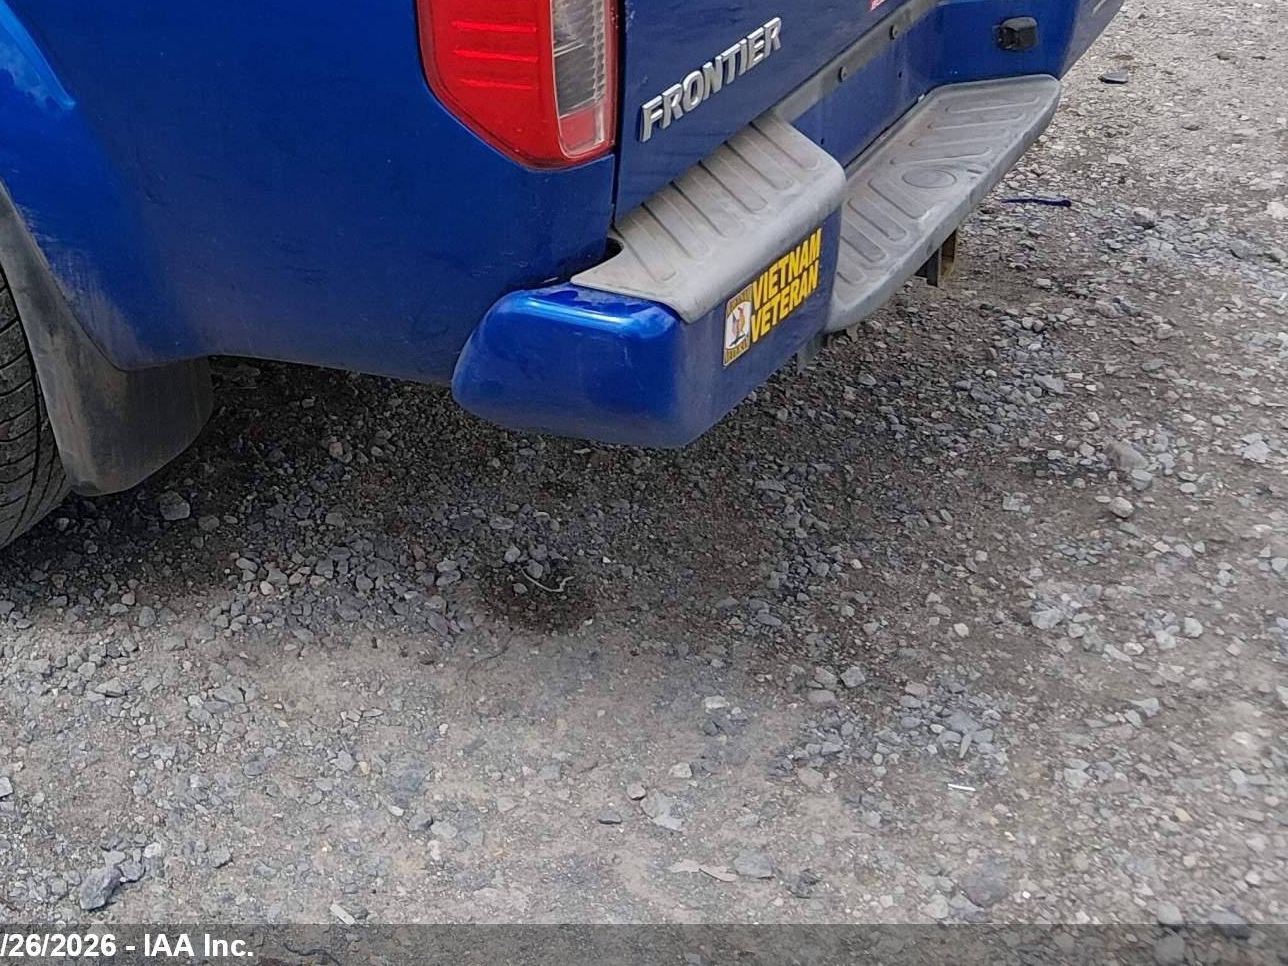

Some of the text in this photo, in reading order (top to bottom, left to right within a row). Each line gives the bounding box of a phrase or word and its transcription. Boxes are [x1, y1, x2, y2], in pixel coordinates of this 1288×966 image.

[641, 16, 782, 143] FRONTIER
[750, 259, 820, 343] VETERAN
[751, 227, 822, 311] VIETNAM
